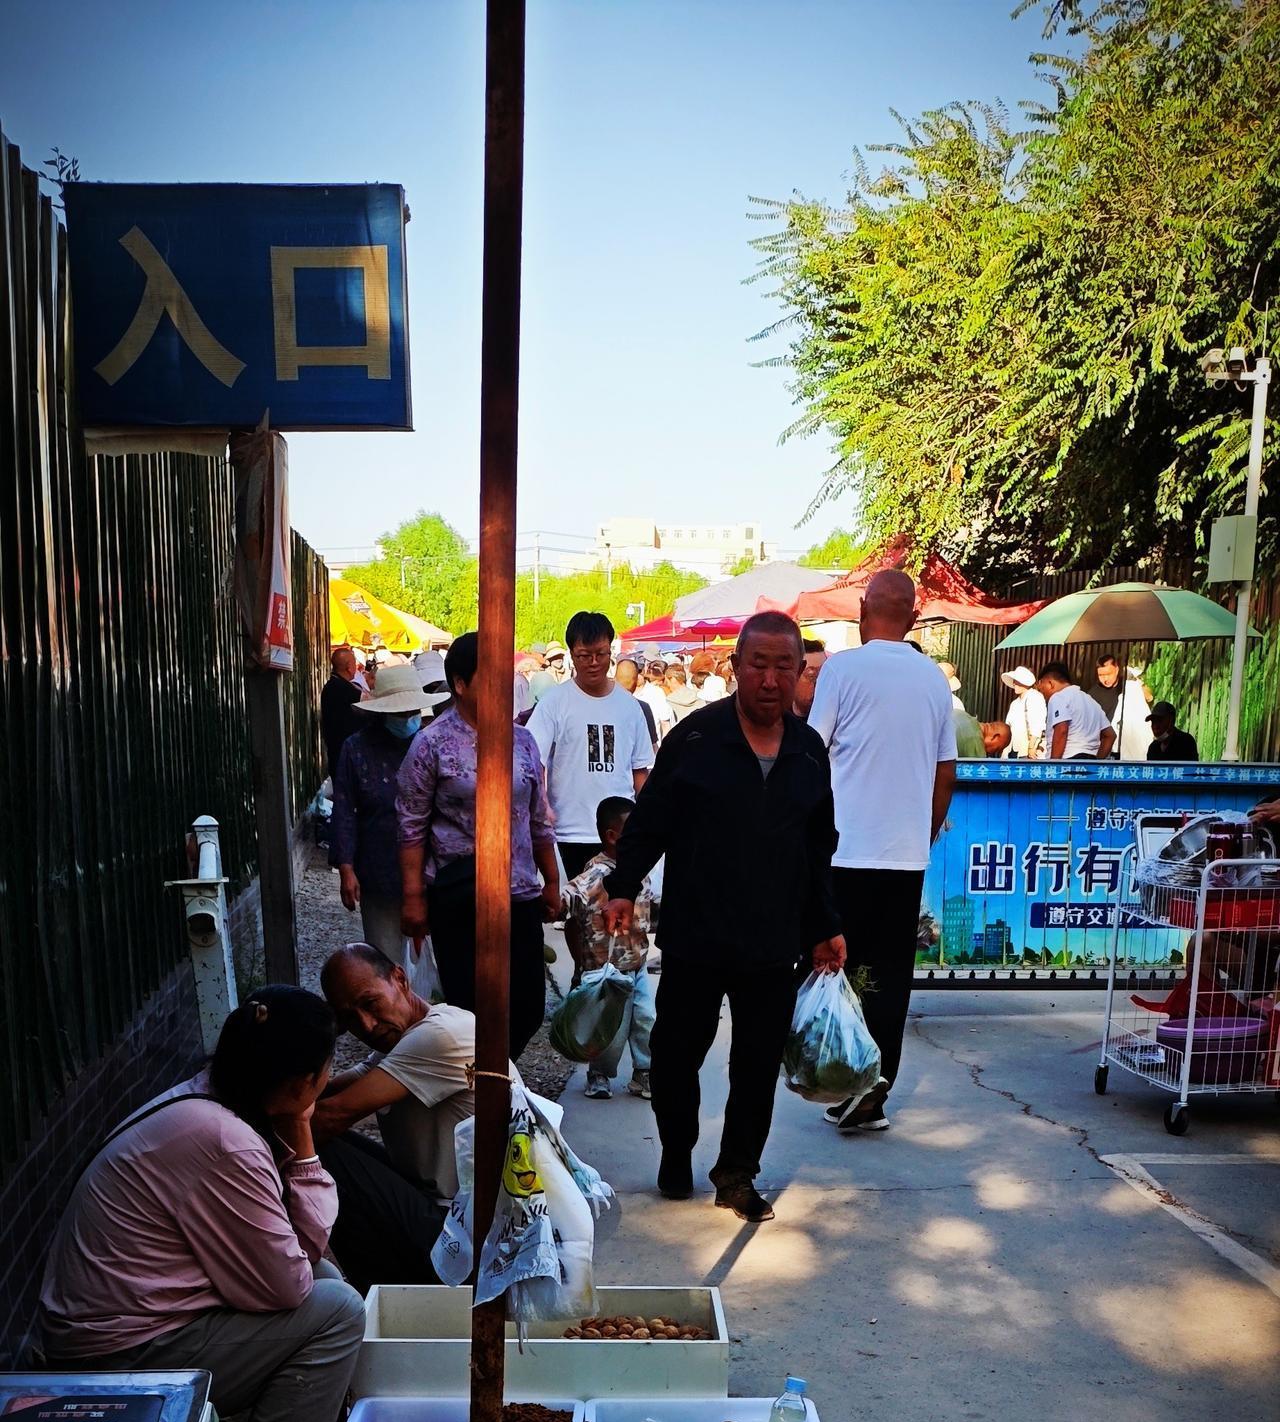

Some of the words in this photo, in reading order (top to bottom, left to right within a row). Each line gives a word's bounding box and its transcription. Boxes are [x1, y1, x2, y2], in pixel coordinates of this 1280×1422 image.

[92, 224, 391, 389] 入口
[968, 841, 1140, 896] 出行有
